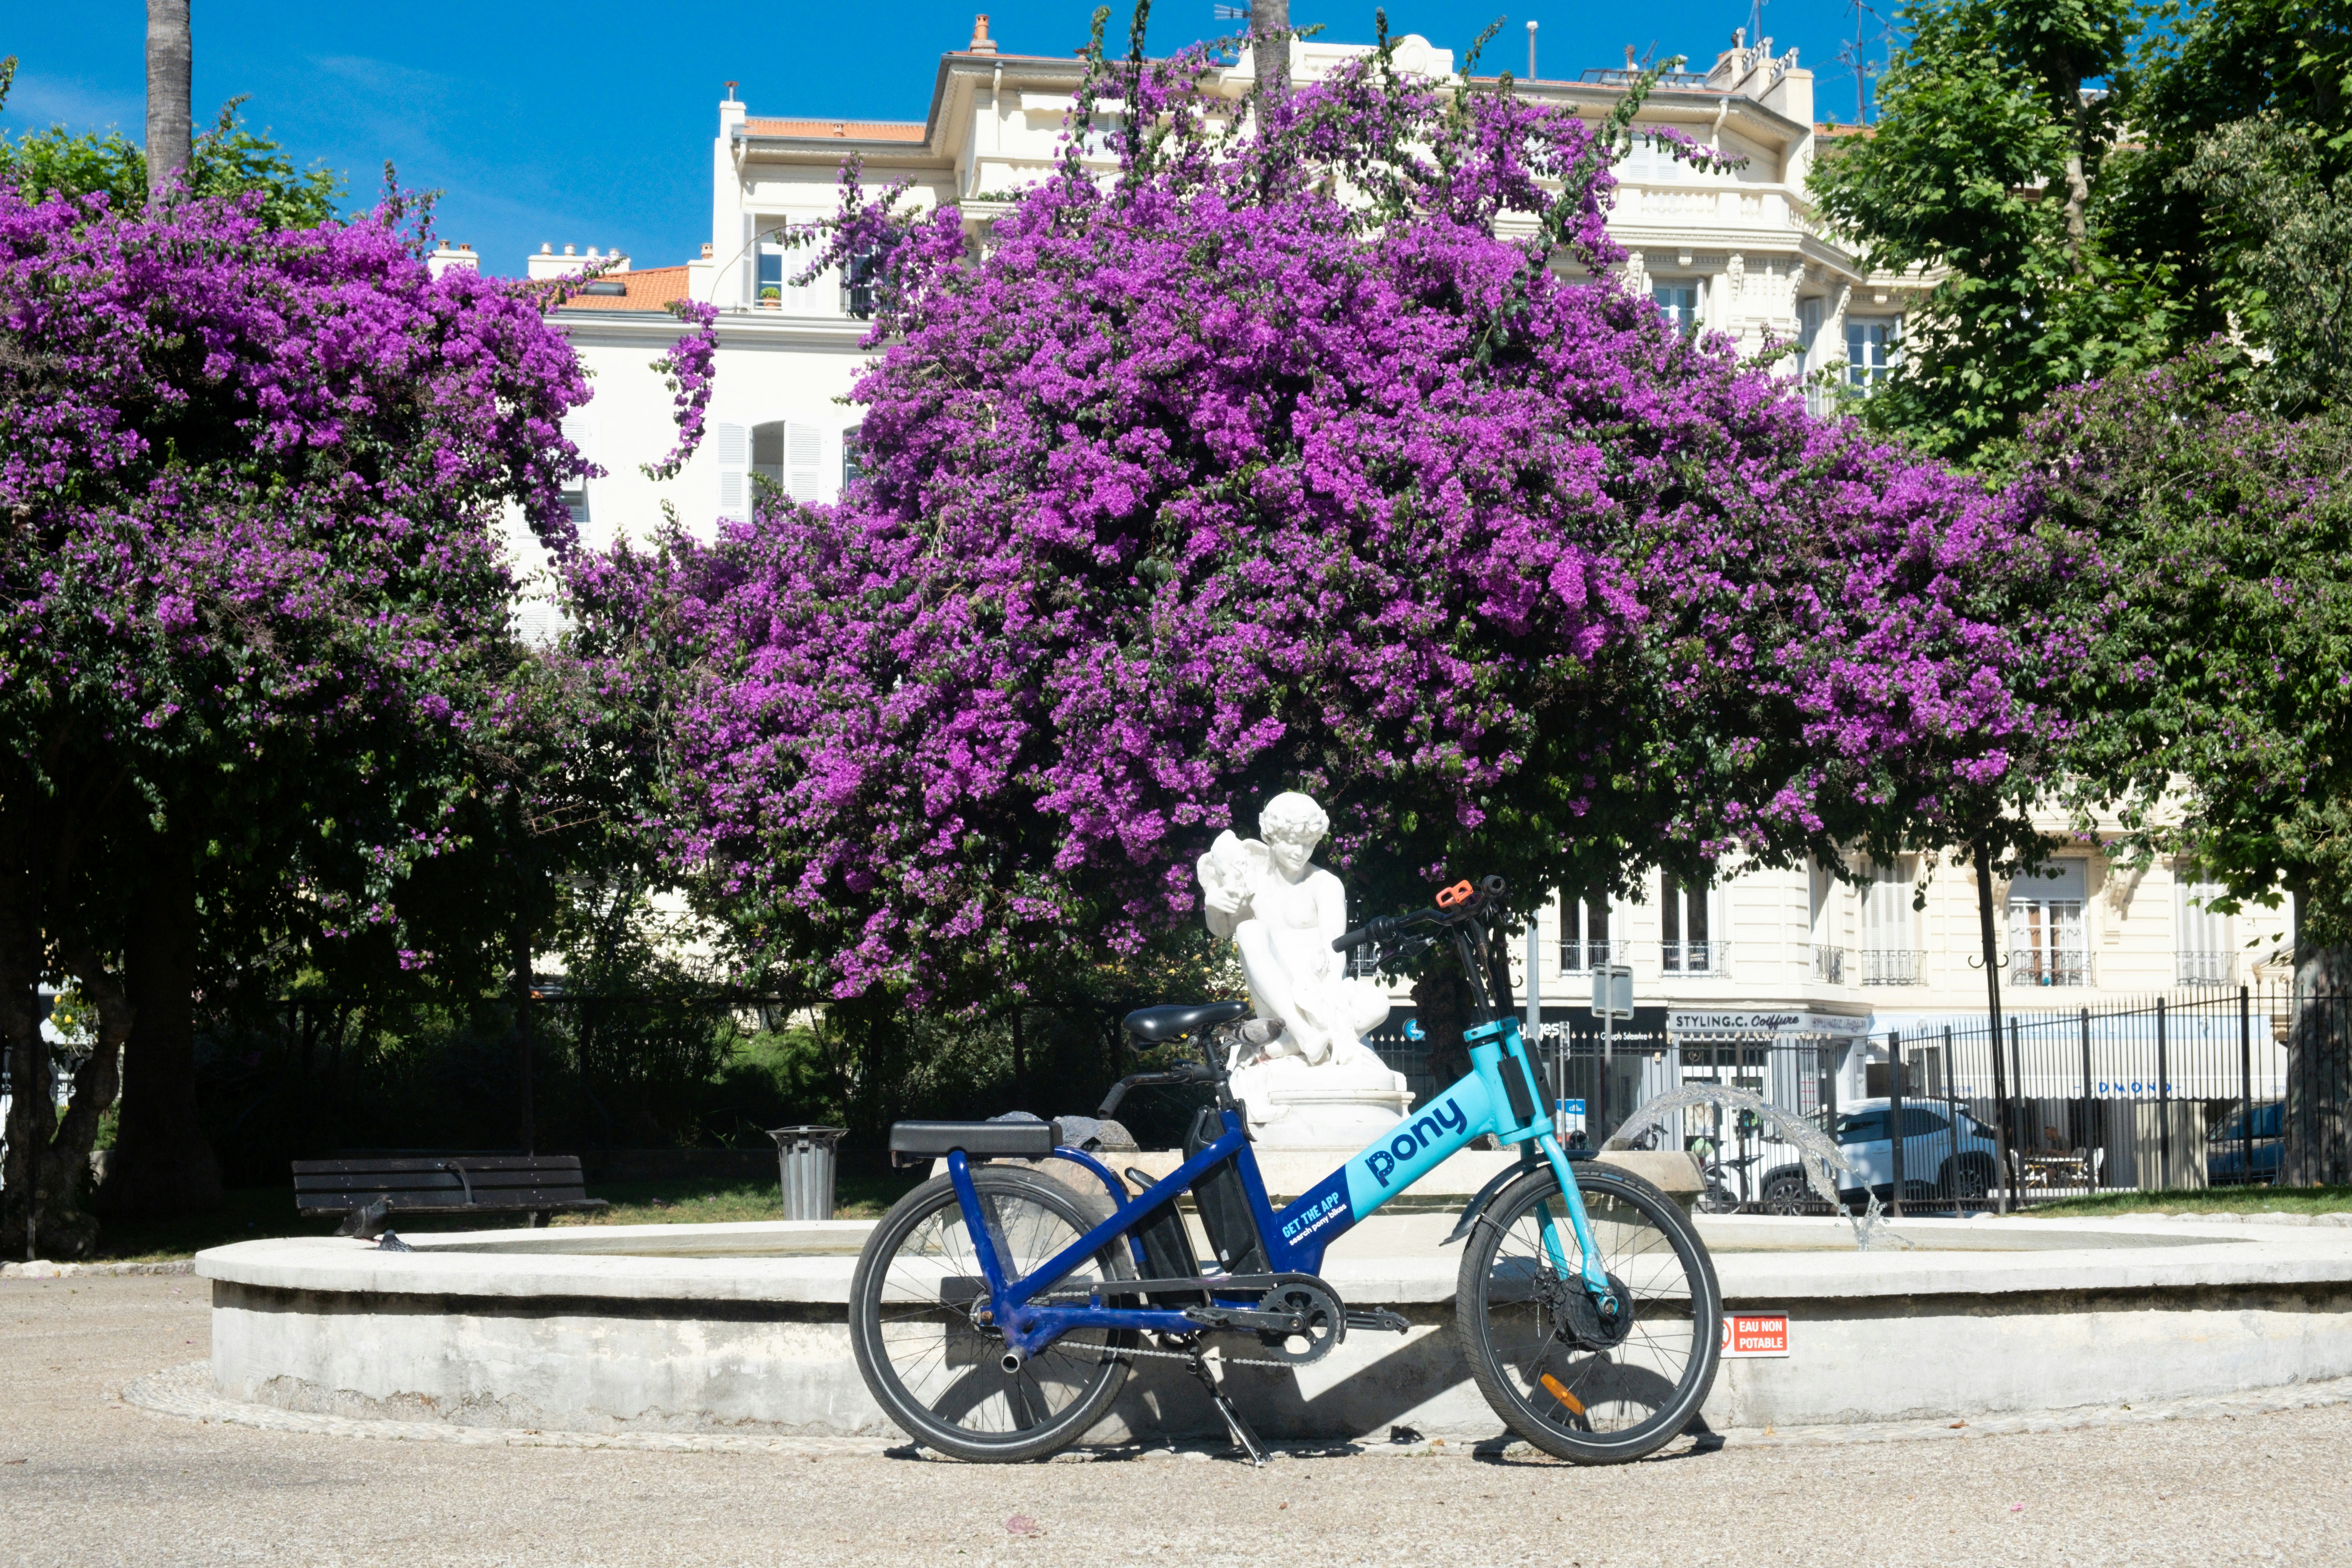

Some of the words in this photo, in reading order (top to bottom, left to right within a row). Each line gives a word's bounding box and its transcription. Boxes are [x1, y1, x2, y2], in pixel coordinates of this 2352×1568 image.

[1676, 1015, 1748, 1027] STYLING.C.
[1751, 1014, 1799, 1030] Coiffure
[1364, 1097, 1467, 1188] pony
[1637, 1186, 1657, 1200] APPLE
[1282, 1218, 1301, 1238] GET
[1300, 1205, 1321, 1225] THE
[1321, 1192, 1339, 1213] APP
[1289, 1227, 1312, 1246] search
[1311, 1216, 1329, 1232] pony
[1328, 1204, 1347, 1219] bikes
[1740, 1321, 1759, 1332] EAU
[1762, 1321, 1782, 1332] NON
[1740, 1337, 1783, 1349] POTABLE
